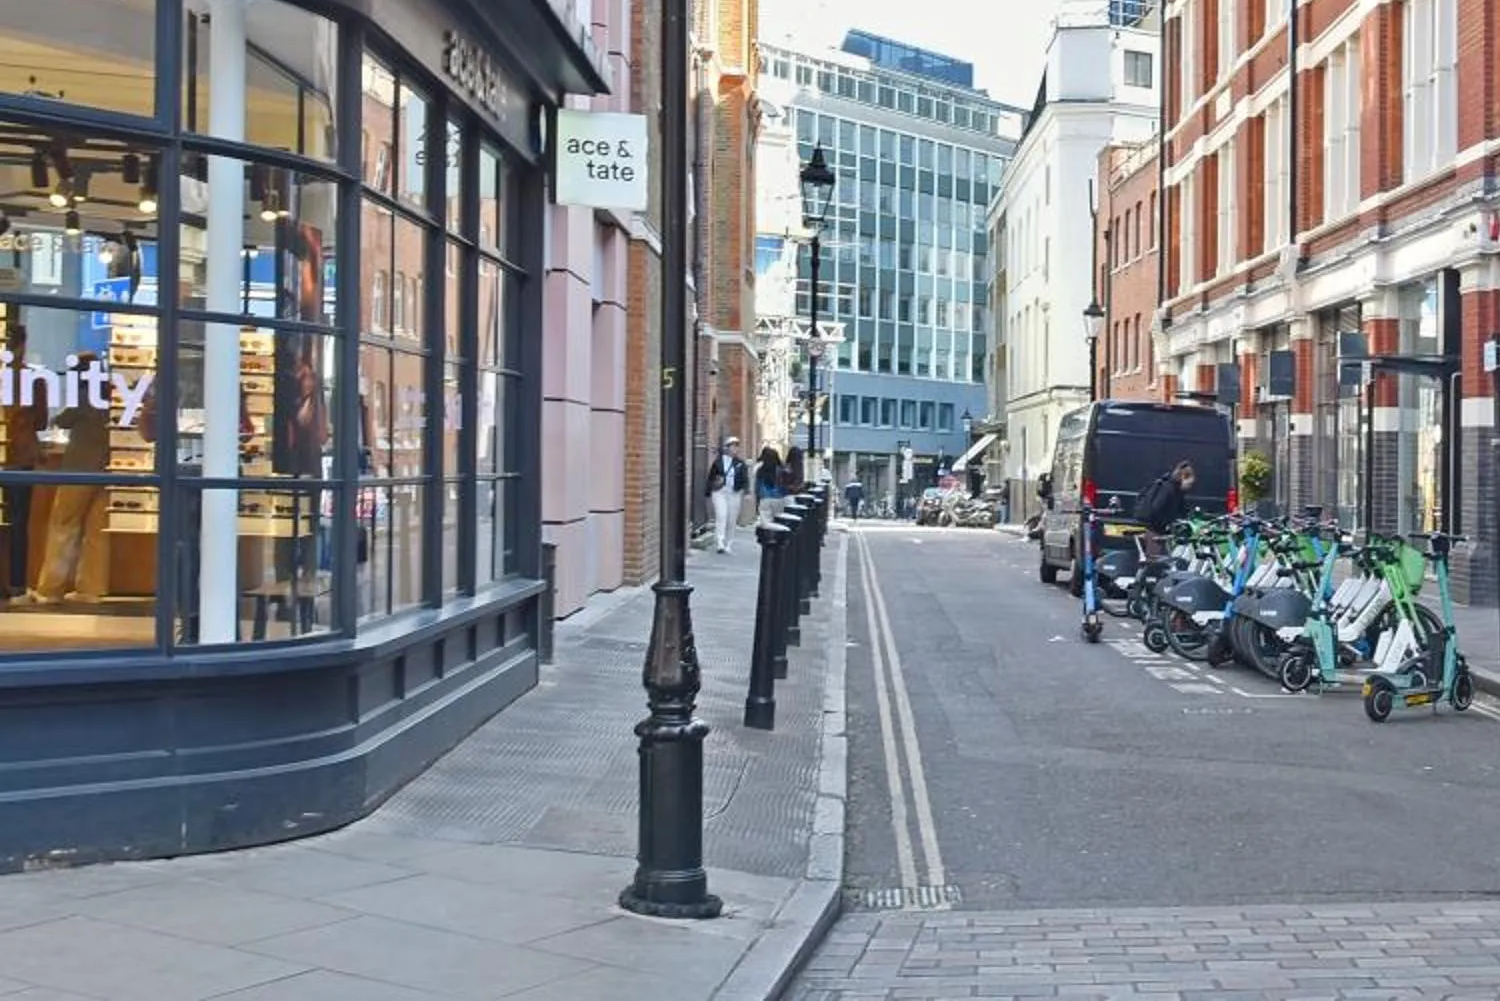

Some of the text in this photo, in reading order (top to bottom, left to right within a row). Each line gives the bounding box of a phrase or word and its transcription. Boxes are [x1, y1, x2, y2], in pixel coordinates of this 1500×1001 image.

[567, 137, 634, 158] ace &
[586, 160, 634, 182] tate
[0, 350, 157, 428] inity
